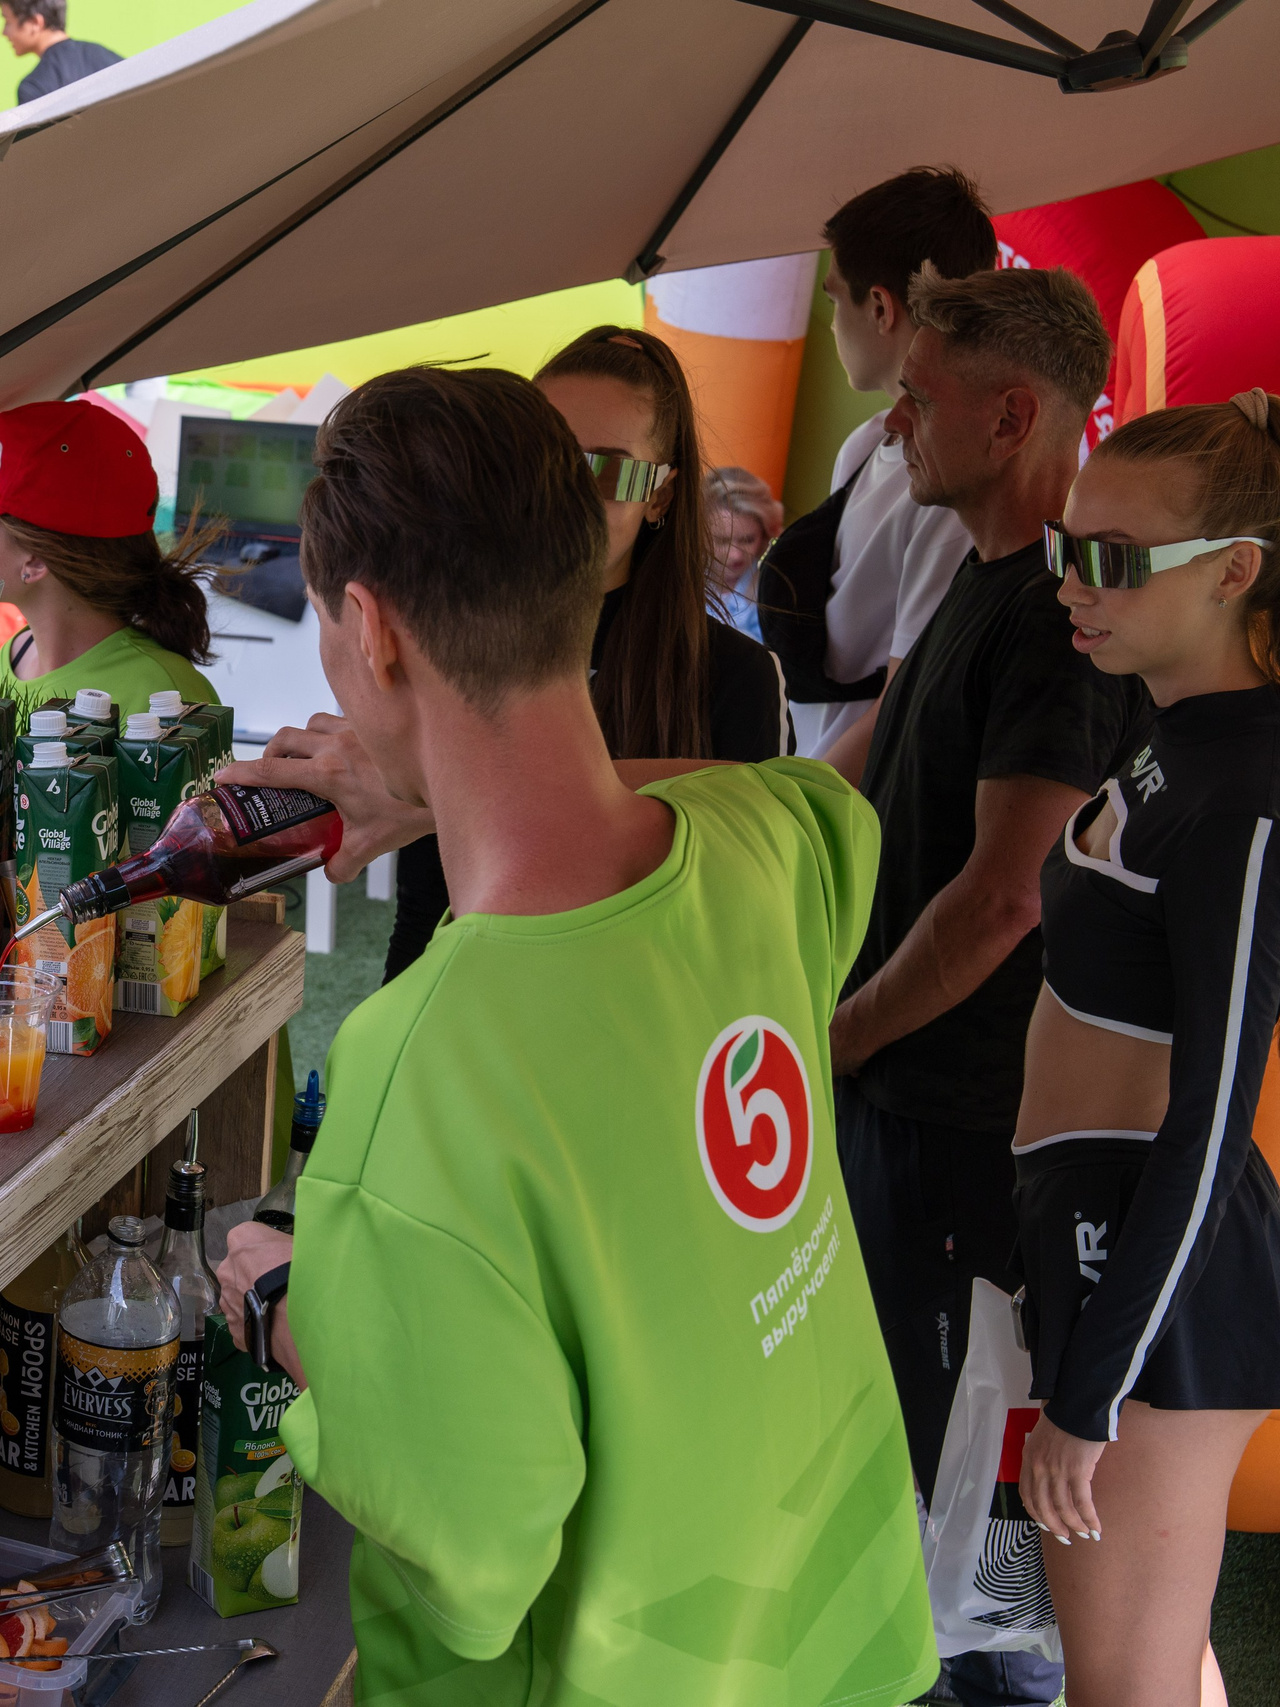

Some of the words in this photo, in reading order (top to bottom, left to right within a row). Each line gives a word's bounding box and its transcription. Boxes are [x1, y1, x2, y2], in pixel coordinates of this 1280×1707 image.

[130, 797, 157, 808] Global
[133, 807, 161, 820] Village
[251, 795, 272, 827] ГРЕНАДИН
[38, 829, 67, 839] Global
[41, 838, 71, 851] Village
[723, 1028, 792, 1191] 5
[750, 1194, 833, 1325] Пятёрочка
[761, 1223, 841, 1359] выручает!
[64, 1381, 132, 1419] EVERVESS
[24, 1405, 41, 1461] KITCHEN
[66, 1420, 94, 1436] ИНДИАН
[95, 1429, 123, 1440] ТОНИК
[244, 1441, 276, 1450] Яблоко
[254, 1450, 269, 1459] 100%
[163, 1476, 196, 1502] AR
